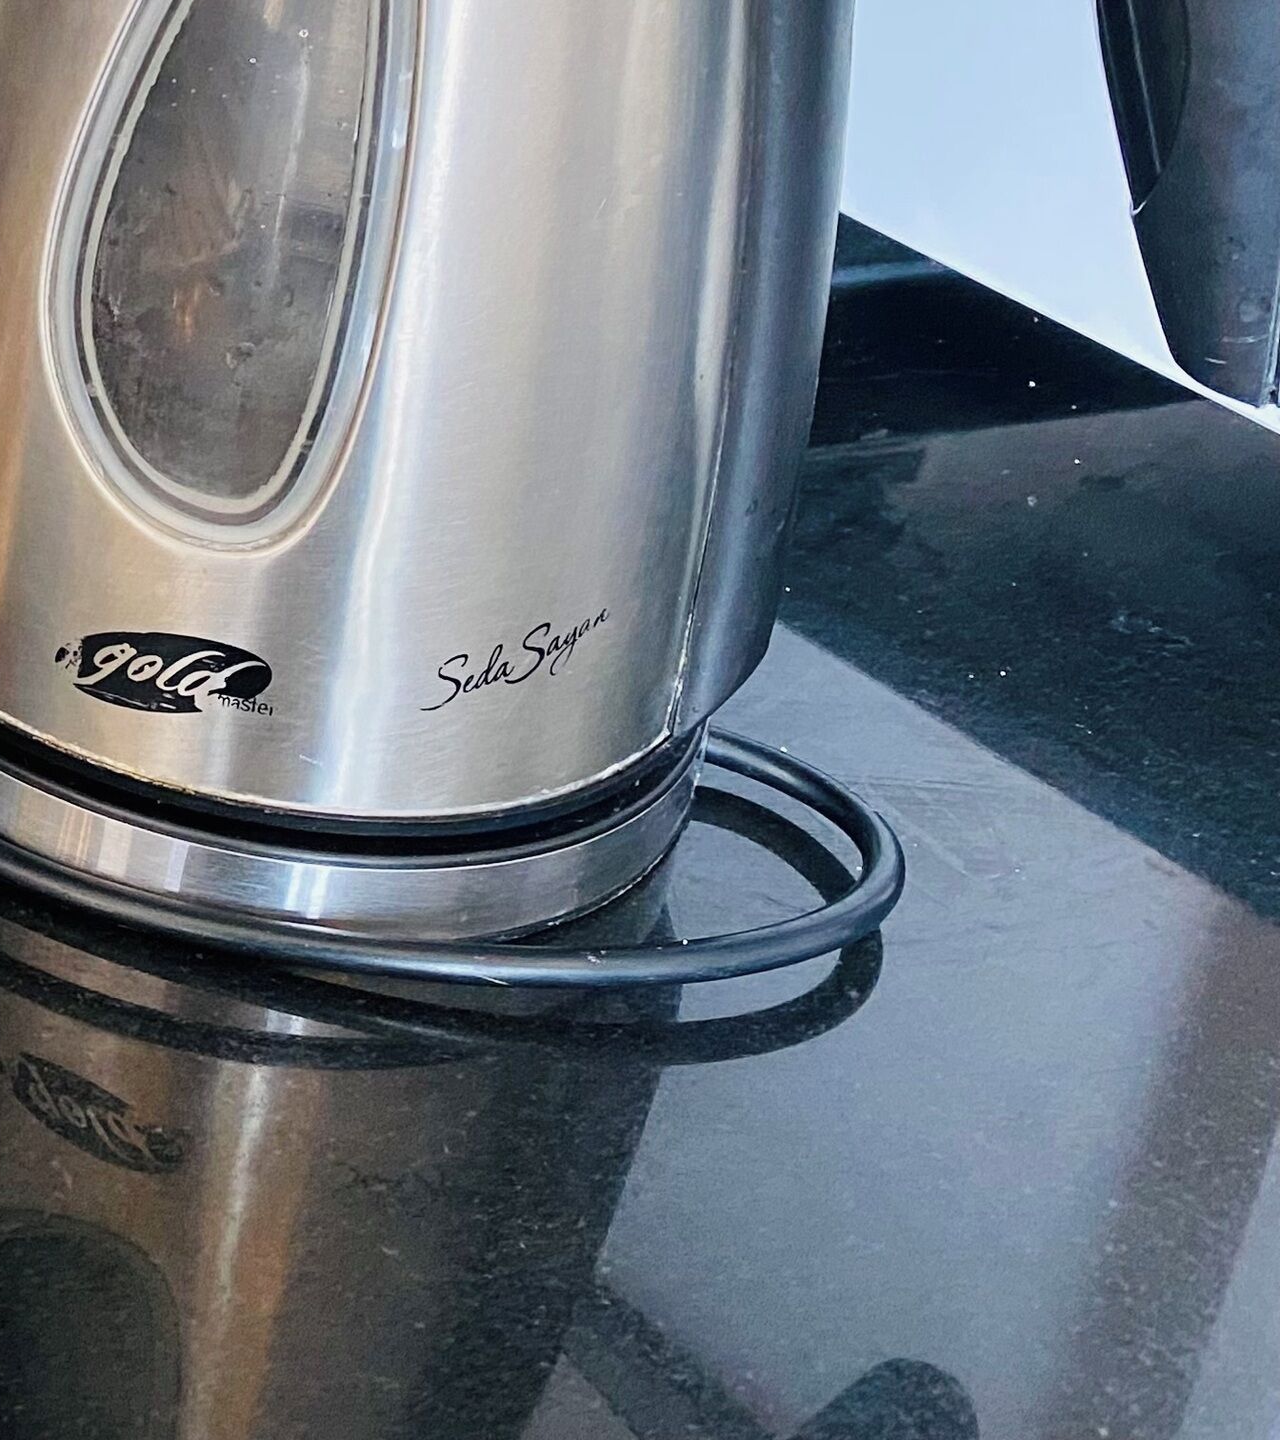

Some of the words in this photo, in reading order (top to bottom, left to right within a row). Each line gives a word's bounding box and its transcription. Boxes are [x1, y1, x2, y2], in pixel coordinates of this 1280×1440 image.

[73, 643, 267, 700] gold
[420, 644, 515, 711] Seda
[504, 608, 610, 685] Sayan
